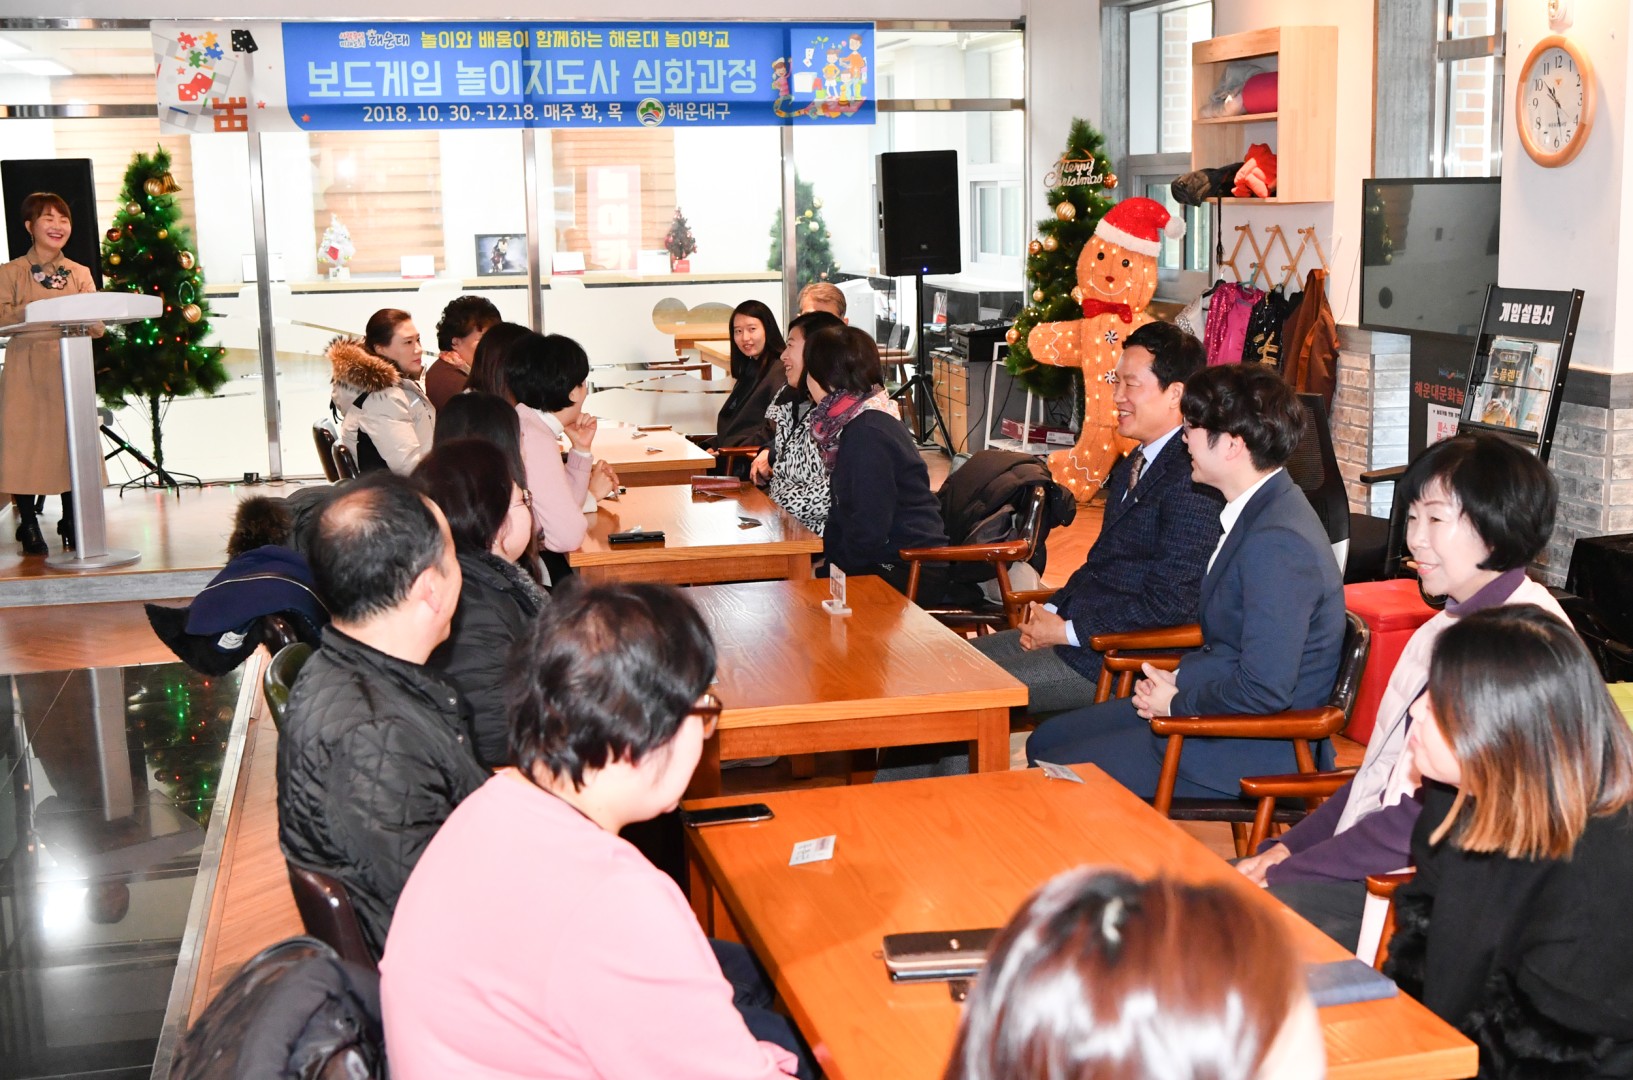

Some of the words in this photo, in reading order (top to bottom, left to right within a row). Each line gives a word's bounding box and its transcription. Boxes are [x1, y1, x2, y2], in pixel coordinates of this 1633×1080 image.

[368, 30, 411, 49] 해운대
[420, 30, 473, 49] 놀이와
[478, 30, 530, 49] 배움이
[536, 30, 603, 48] 함께하는
[609, 29, 660, 48] 해운대
[664, 29, 730, 48] 놀이학교
[1543, 62, 1549, 76] 11
[1554, 55, 1562, 69] 12
[308, 60, 442, 97] 보드게임
[455, 59, 621, 96] 놀이지도사
[632, 58, 757, 95] 심화과정
[1535, 78, 1544, 92] 10
[1576, 73, 1581, 88] 2
[1532, 97, 1539, 110] 9
[1577, 92, 1583, 107] 3
[362, 106, 412, 122] 2018.
[417, 105, 444, 122] 10.
[543, 103, 576, 121] 매주
[580, 103, 603, 123] 화,
[607, 103, 623, 121] 목
[667, 102, 731, 121] 해운대구
[1535, 116, 1541, 130] 8
[1573, 113, 1579, 127] 4
[1554, 135, 1560, 149] 6
[1566, 130, 1571, 144] 5
[1053, 158, 1095, 177] Merry
[1043, 171, 1104, 188] Christmas
[1498, 302, 1555, 326] 게임설명서
